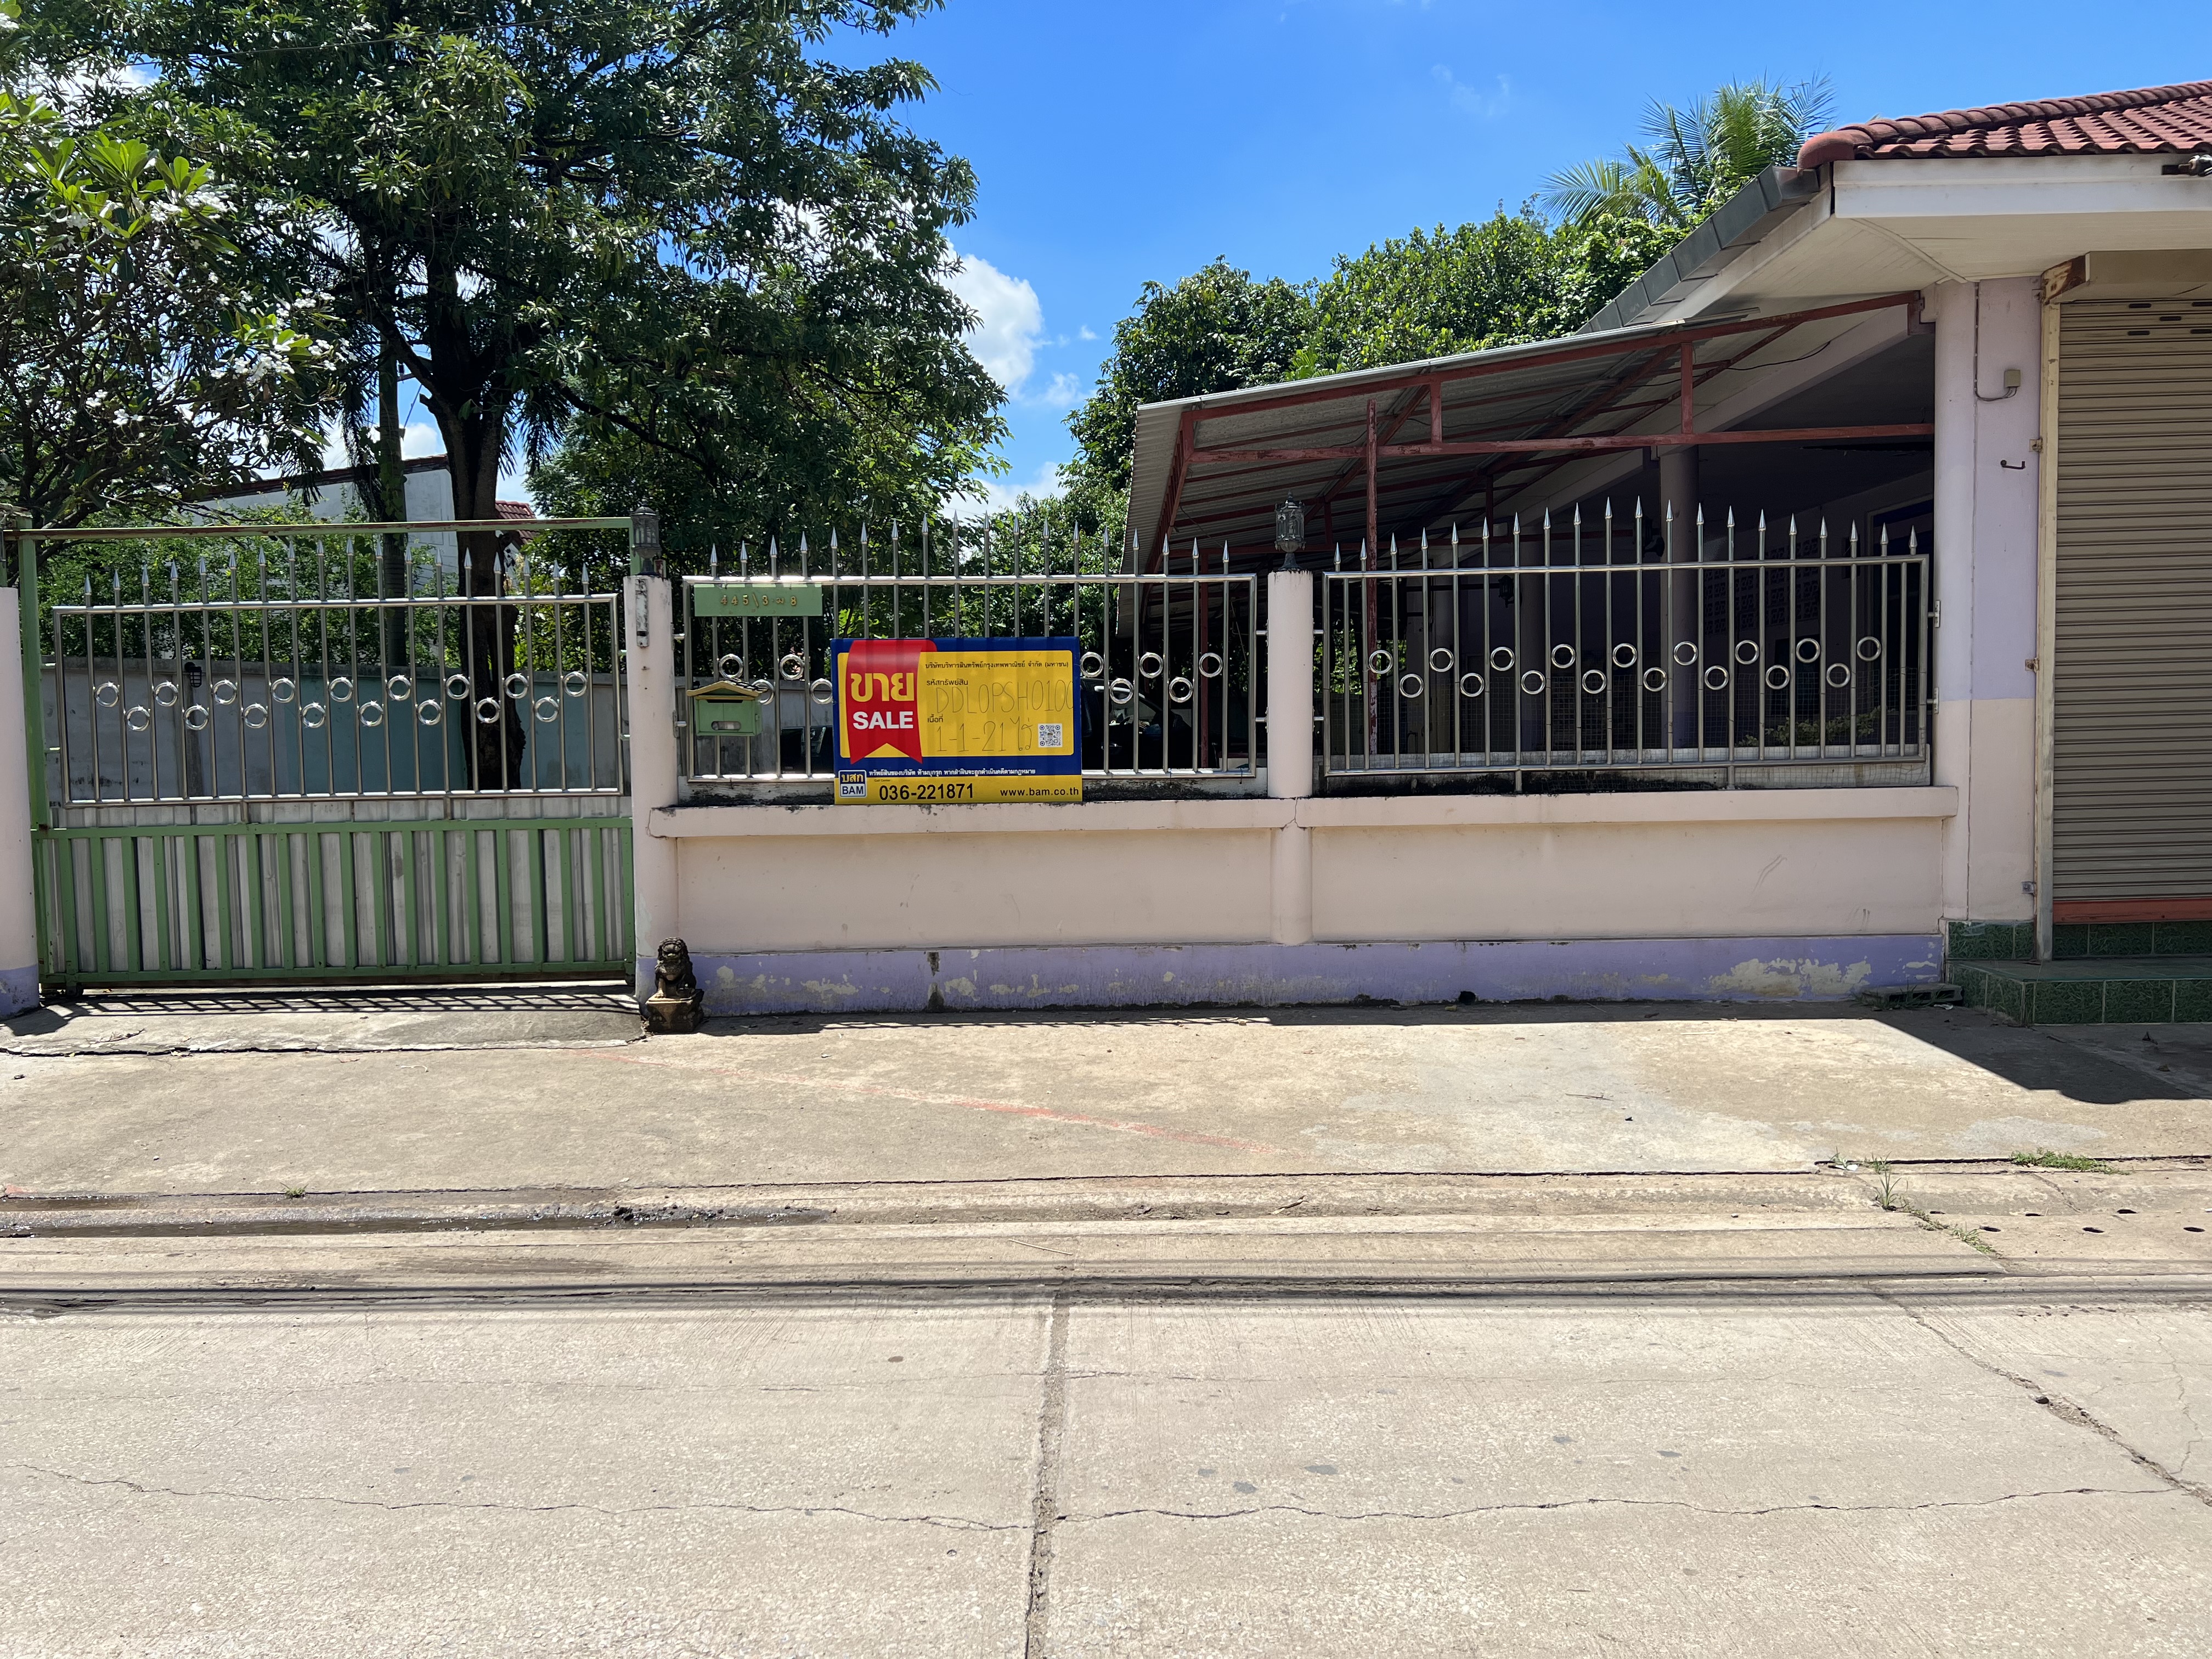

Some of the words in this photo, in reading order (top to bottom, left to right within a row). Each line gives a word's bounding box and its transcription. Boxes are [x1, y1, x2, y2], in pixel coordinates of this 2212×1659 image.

[850, 672, 915, 702] ขาย
[853, 711, 914, 730] SALE
[927, 713, 944, 723] เนื้อที่
[1009, 715, 1034, 752] ไร่
[841, 773, 864, 783] บสก
[917, 769, 943, 777] ห้ามบุกรุก
[842, 786, 864, 795] BAM
[879, 783, 974, 800] 036-221871
[1000, 787, 1079, 796] www.bam.co.th
